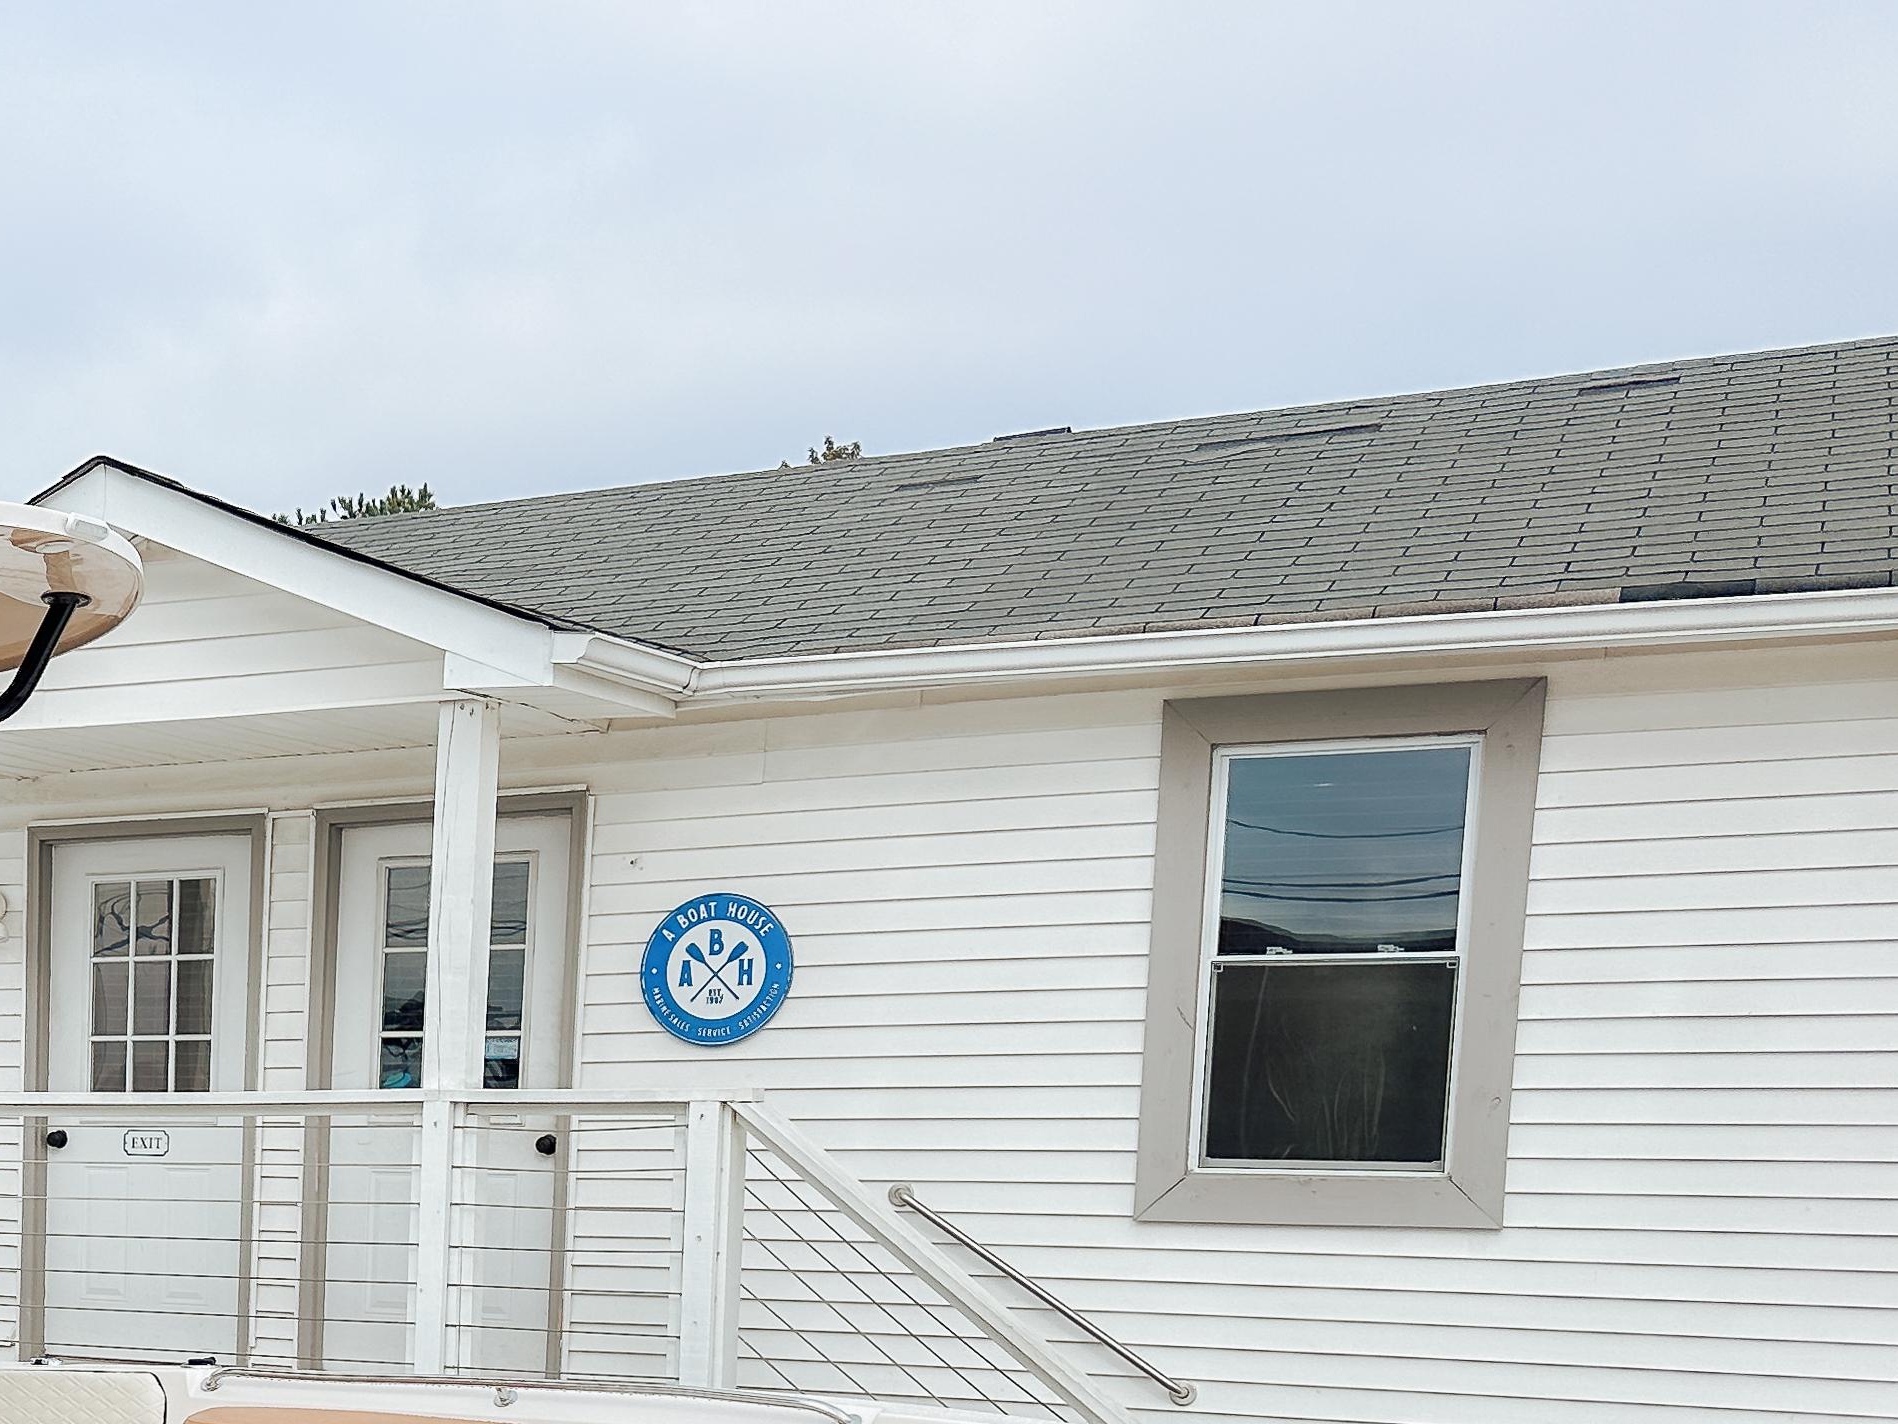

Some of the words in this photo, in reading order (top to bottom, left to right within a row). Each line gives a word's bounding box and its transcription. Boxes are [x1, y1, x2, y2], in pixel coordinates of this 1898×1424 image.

[662, 928, 675, 941] A
[676, 901, 717, 929] BOAT
[727, 901, 774, 937] HOUSE
[697, 1026, 731, 1037] SERVICE
[131, 1136, 163, 1149] EXIT
